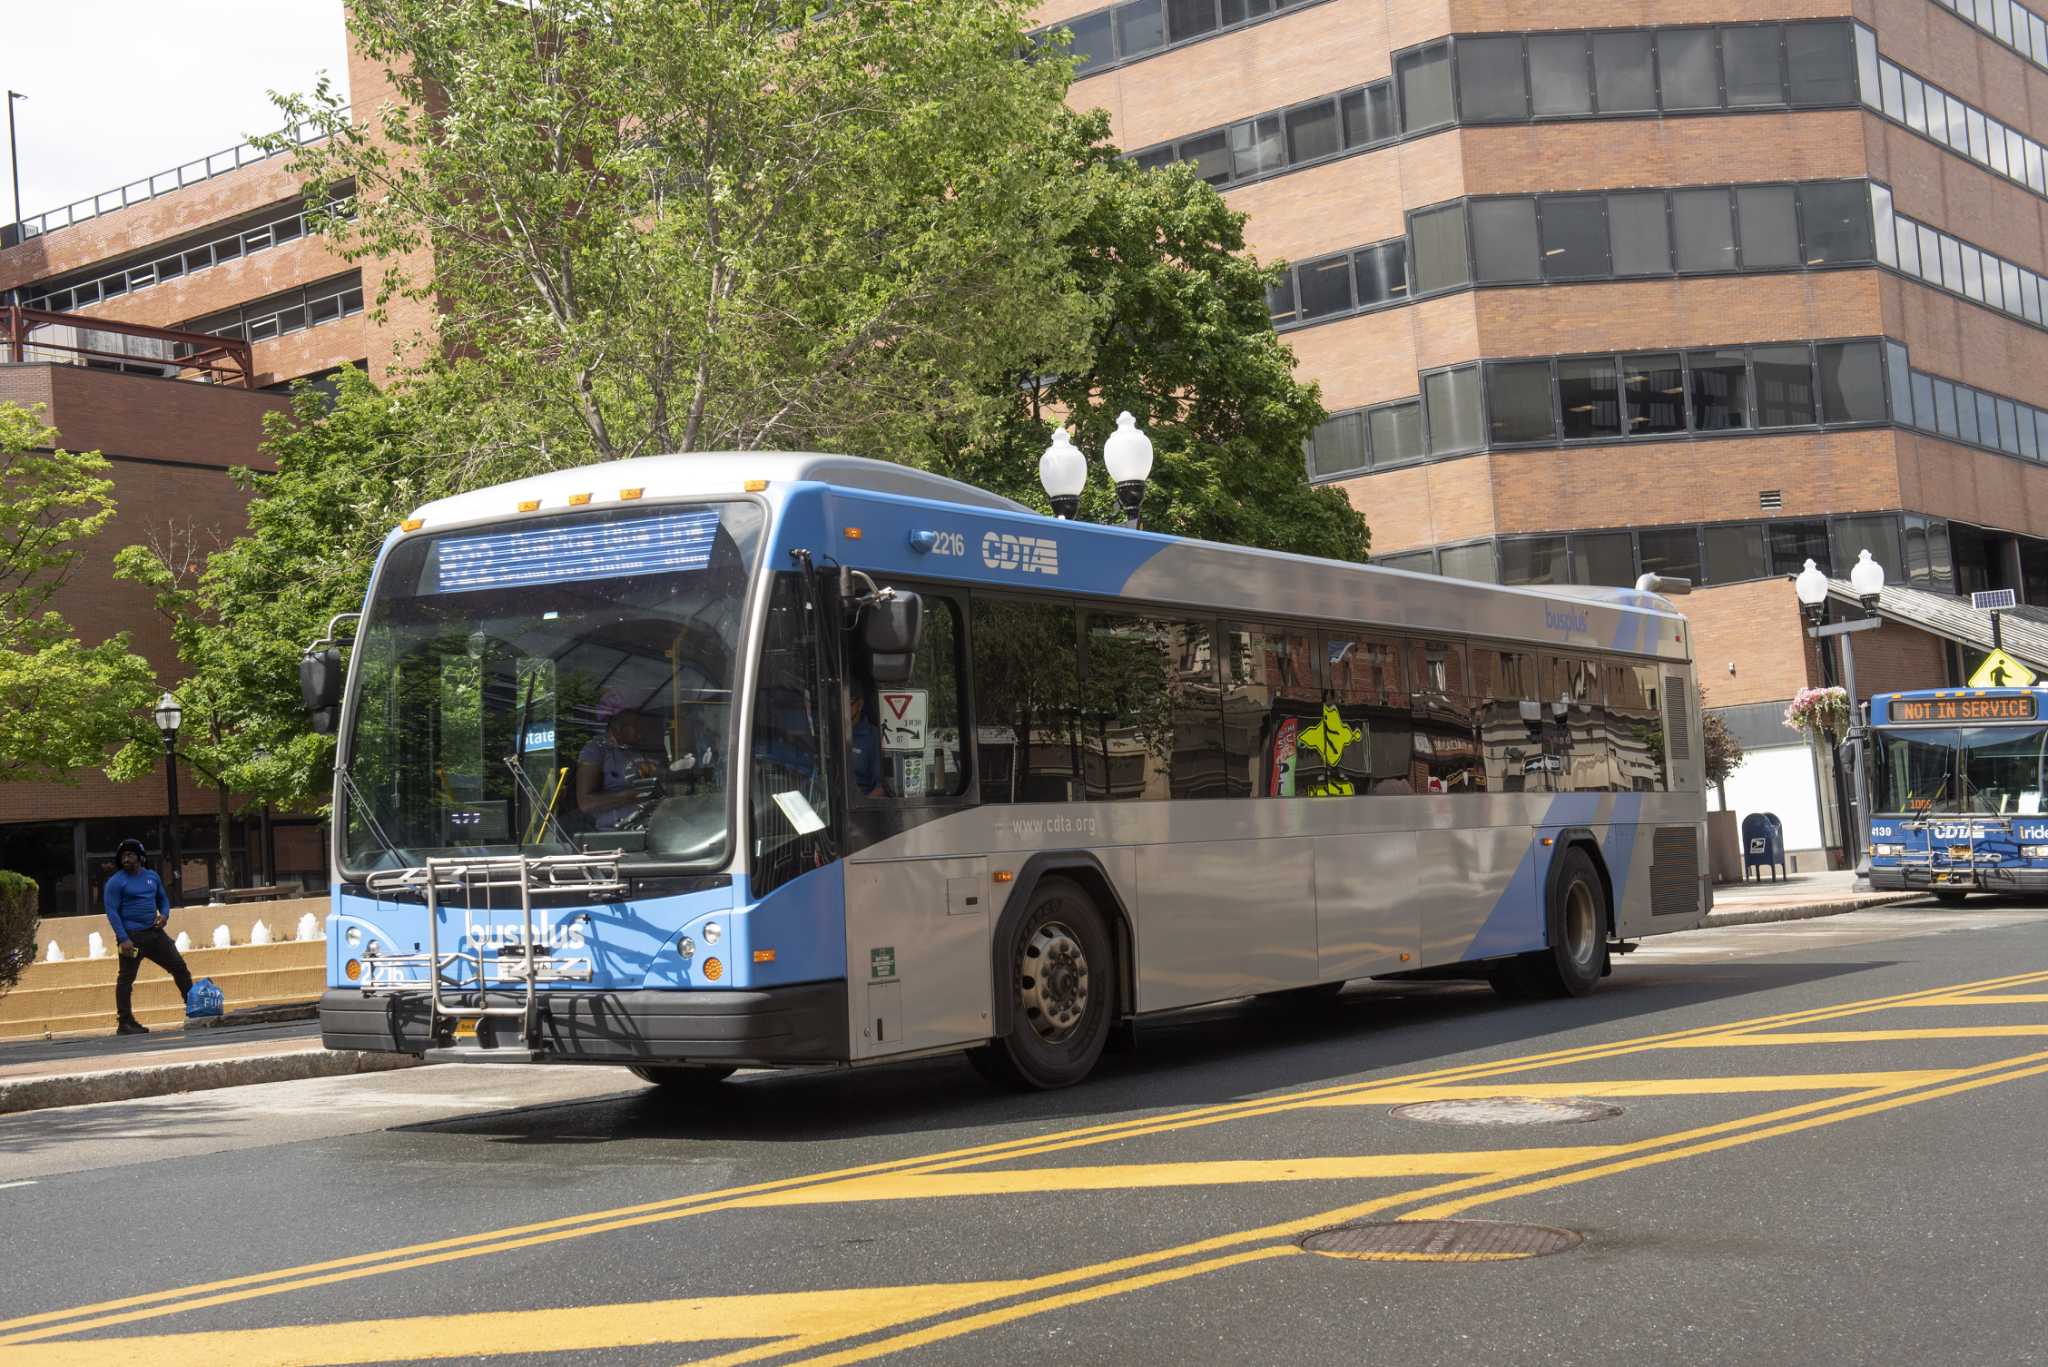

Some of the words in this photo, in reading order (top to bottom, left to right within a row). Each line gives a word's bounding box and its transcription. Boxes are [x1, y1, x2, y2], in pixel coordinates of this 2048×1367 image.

[931, 531, 965, 556] 2216
[982, 531, 1058, 575] CDTA
[1904, 703, 1931, 720] NOT
[1937, 702, 1956, 718] IN
[1962, 700, 2028, 718] SERVICE
[526, 730, 554, 745] tate
[1012, 815, 1096, 837] www.cdta.org
